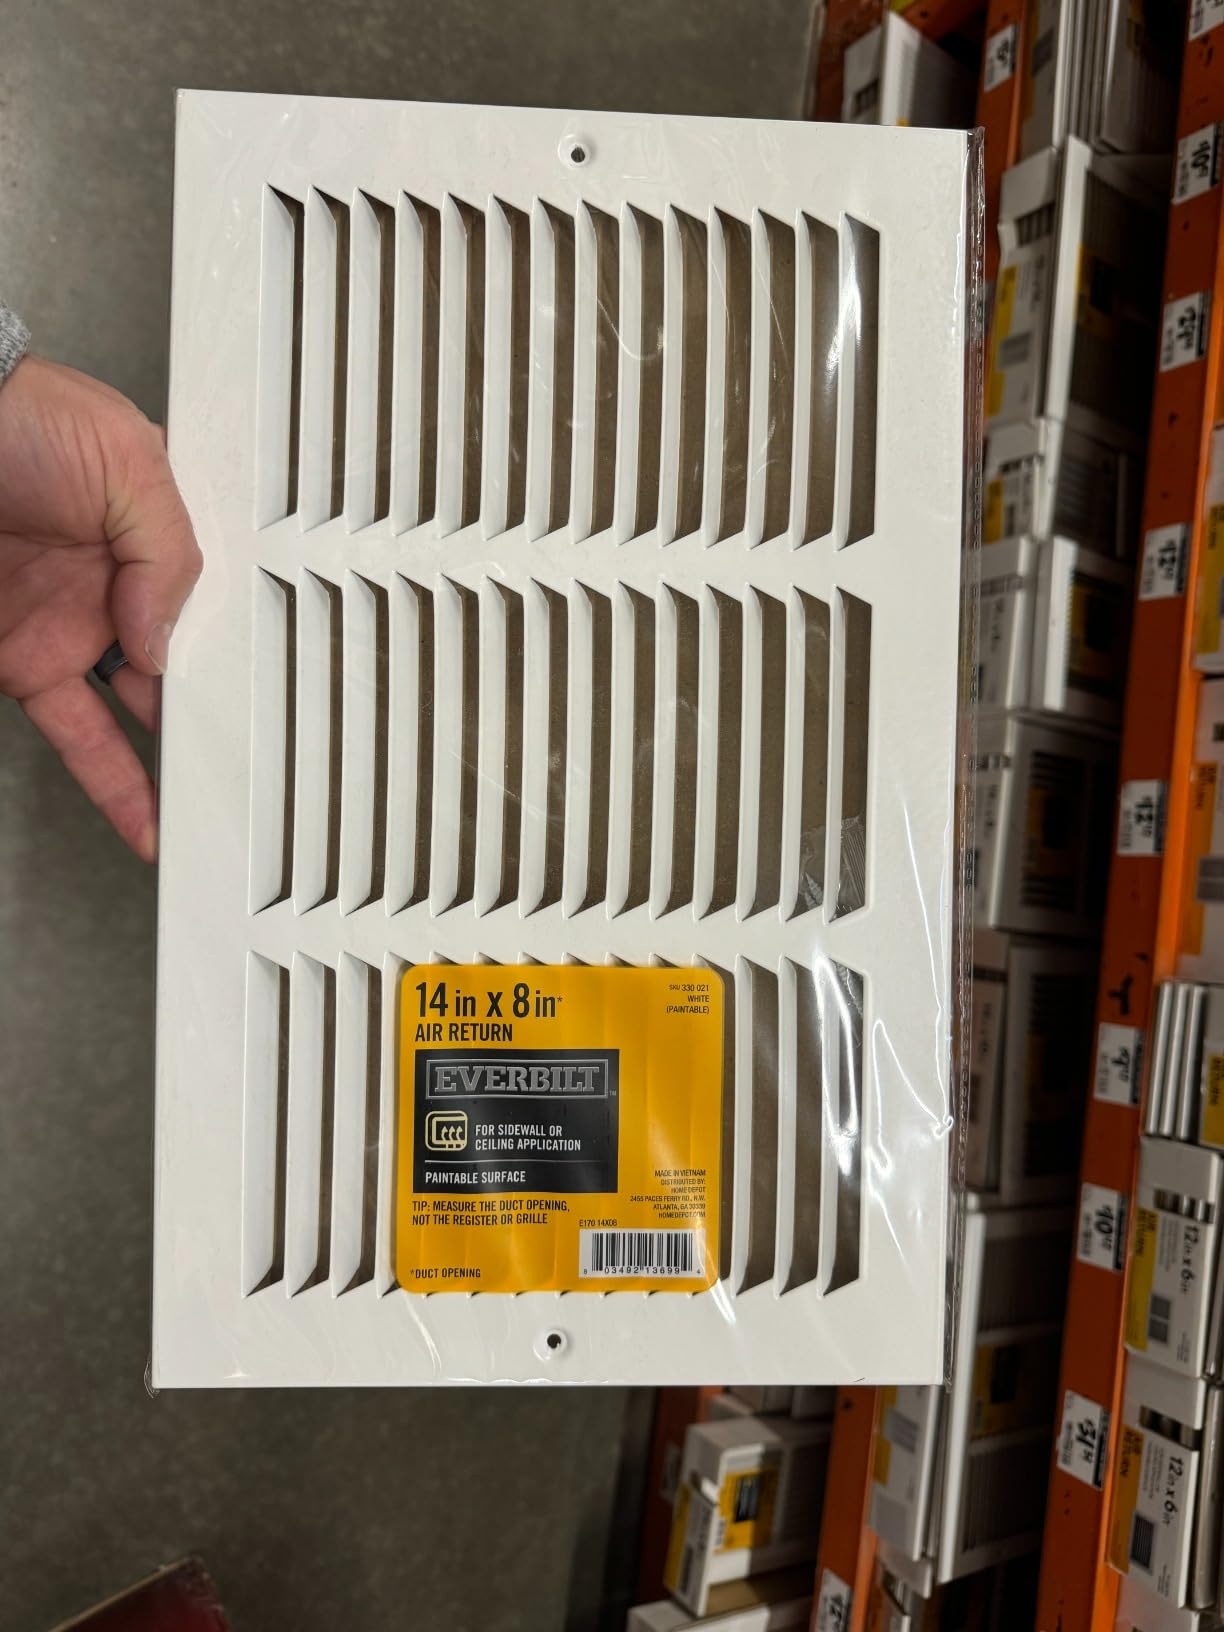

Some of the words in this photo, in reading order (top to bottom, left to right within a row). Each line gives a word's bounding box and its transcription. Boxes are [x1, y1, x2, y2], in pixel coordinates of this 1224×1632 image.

[681, 984, 695, 992] 330
[697, 984, 709, 992] 021
[666, 1005, 709, 1014] (PAINTABLE)
[415, 1023, 442, 1042] AIR
[449, 1023, 512, 1041] RETURN
[434, 1066, 600, 1092] EVERBILT
[475, 1124, 495, 1136] FOR
[498, 1124, 546, 1136] SIDEWALL
[549, 1125, 562, 1137] OR
[475, 1139, 514, 1150] CEILING
[517, 1139, 581, 1151] APPLICATION
[425, 1171, 478, 1184] PAINTABLE
[481, 1170, 526, 1183] SURFACE
[412, 1200, 430, 1212] TIP:
[432, 1201, 476, 1212] MEASURE
[480, 1201, 496, 1212] THE
[499, 1200, 524, 1211] DUCT
[526, 1200, 570, 1212] OPENING,
[412, 1215, 430, 1226] NOT
[433, 1214, 450, 1224] THE
[453, 1215, 498, 1226] REGISTER
[500, 1214, 513, 1224] OR
[516, 1213, 548, 1224] GRILLE
[579, 1219, 595, 1227] E170
[441, 1268, 481, 1278] OPENING
